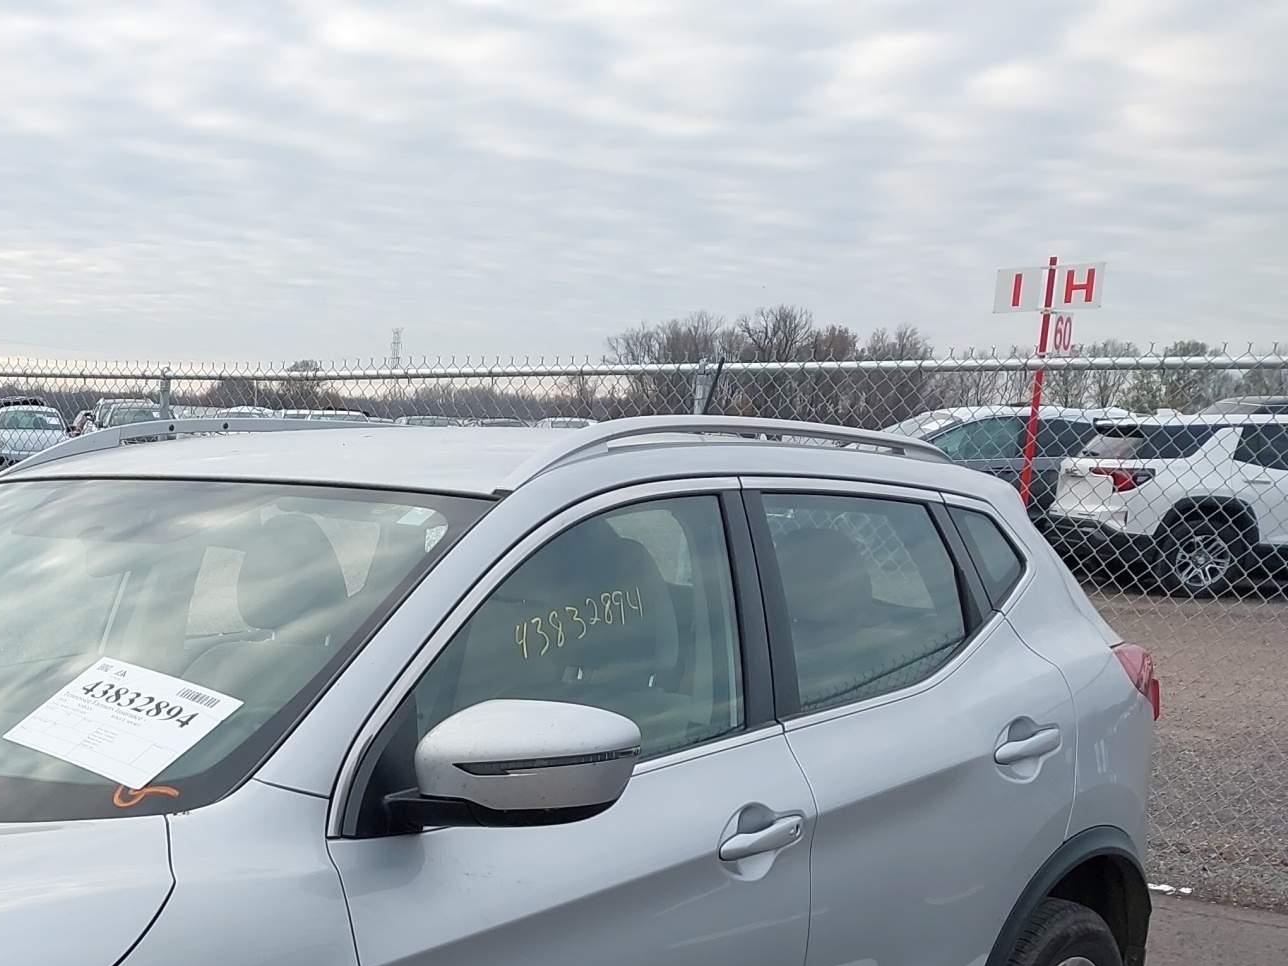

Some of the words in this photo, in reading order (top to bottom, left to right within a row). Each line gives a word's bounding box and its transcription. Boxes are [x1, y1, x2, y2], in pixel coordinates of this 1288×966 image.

[1011, 272, 1024, 307] I
[1063, 267, 1096, 304] H
[1053, 315, 1073, 351] 60
[515, 585, 643, 660] 43832894
[81, 680, 200, 729] 43832894
